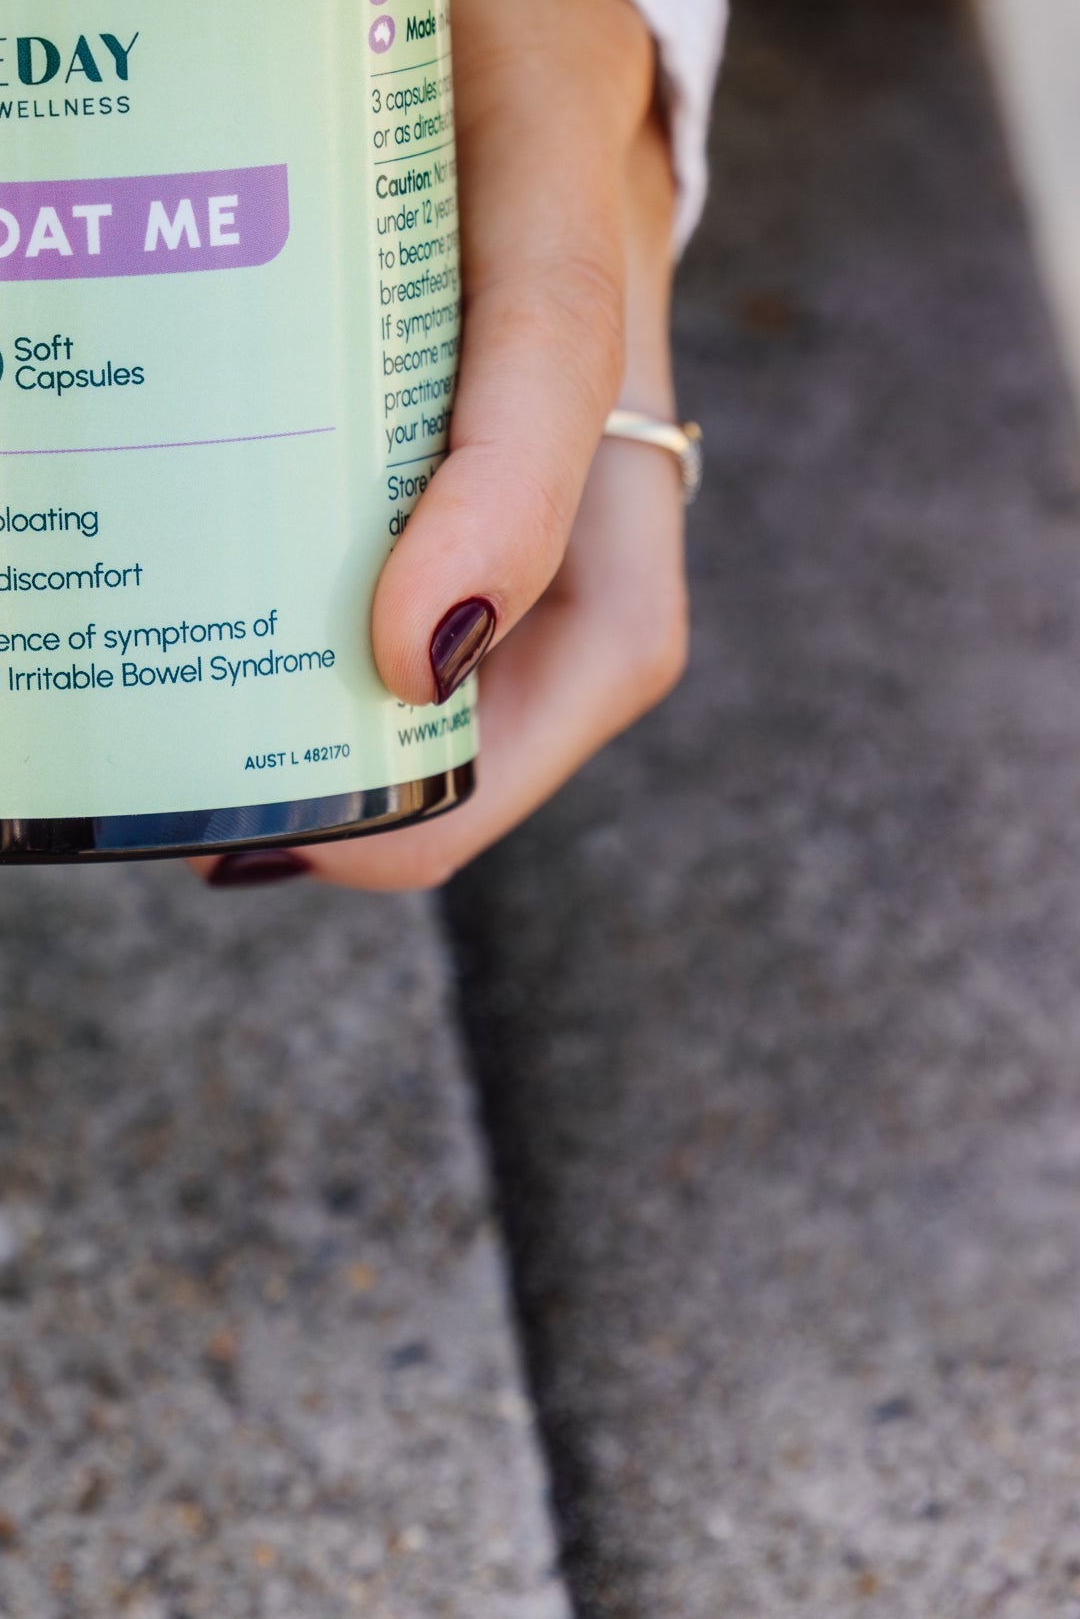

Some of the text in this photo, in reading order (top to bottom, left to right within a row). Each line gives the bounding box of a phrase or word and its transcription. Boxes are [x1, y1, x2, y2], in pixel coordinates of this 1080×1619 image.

[406, 10, 436, 43] Made
[372, 88, 382, 114] 3
[385, 77, 437, 115] capsules
[373, 129, 390, 149] or
[394, 124, 411, 145] as
[376, 168, 432, 199] Caution:
[143, 194, 241, 252] ME
[377, 204, 419, 236] under
[422, 199, 432, 225] 12
[379, 247, 395, 269] to
[399, 237, 445, 267] become
[381, 315, 392, 341] If
[396, 303, 453, 344] symptoms
[15, 333, 74, 362] Soft
[383, 346, 439, 376] become
[15, 360, 145, 397] Capsules
[386, 420, 418, 453] your
[387, 474, 428, 501] Store
[68, 623, 97, 650] of
[103, 620, 247, 656] symptoms
[253, 609, 278, 637] of
[8, 662, 114, 691] Irritable
[121, 657, 203, 687] Bowel
[209, 648, 336, 687] Syndrome
[244, 743, 350, 771] AUST L 482170
